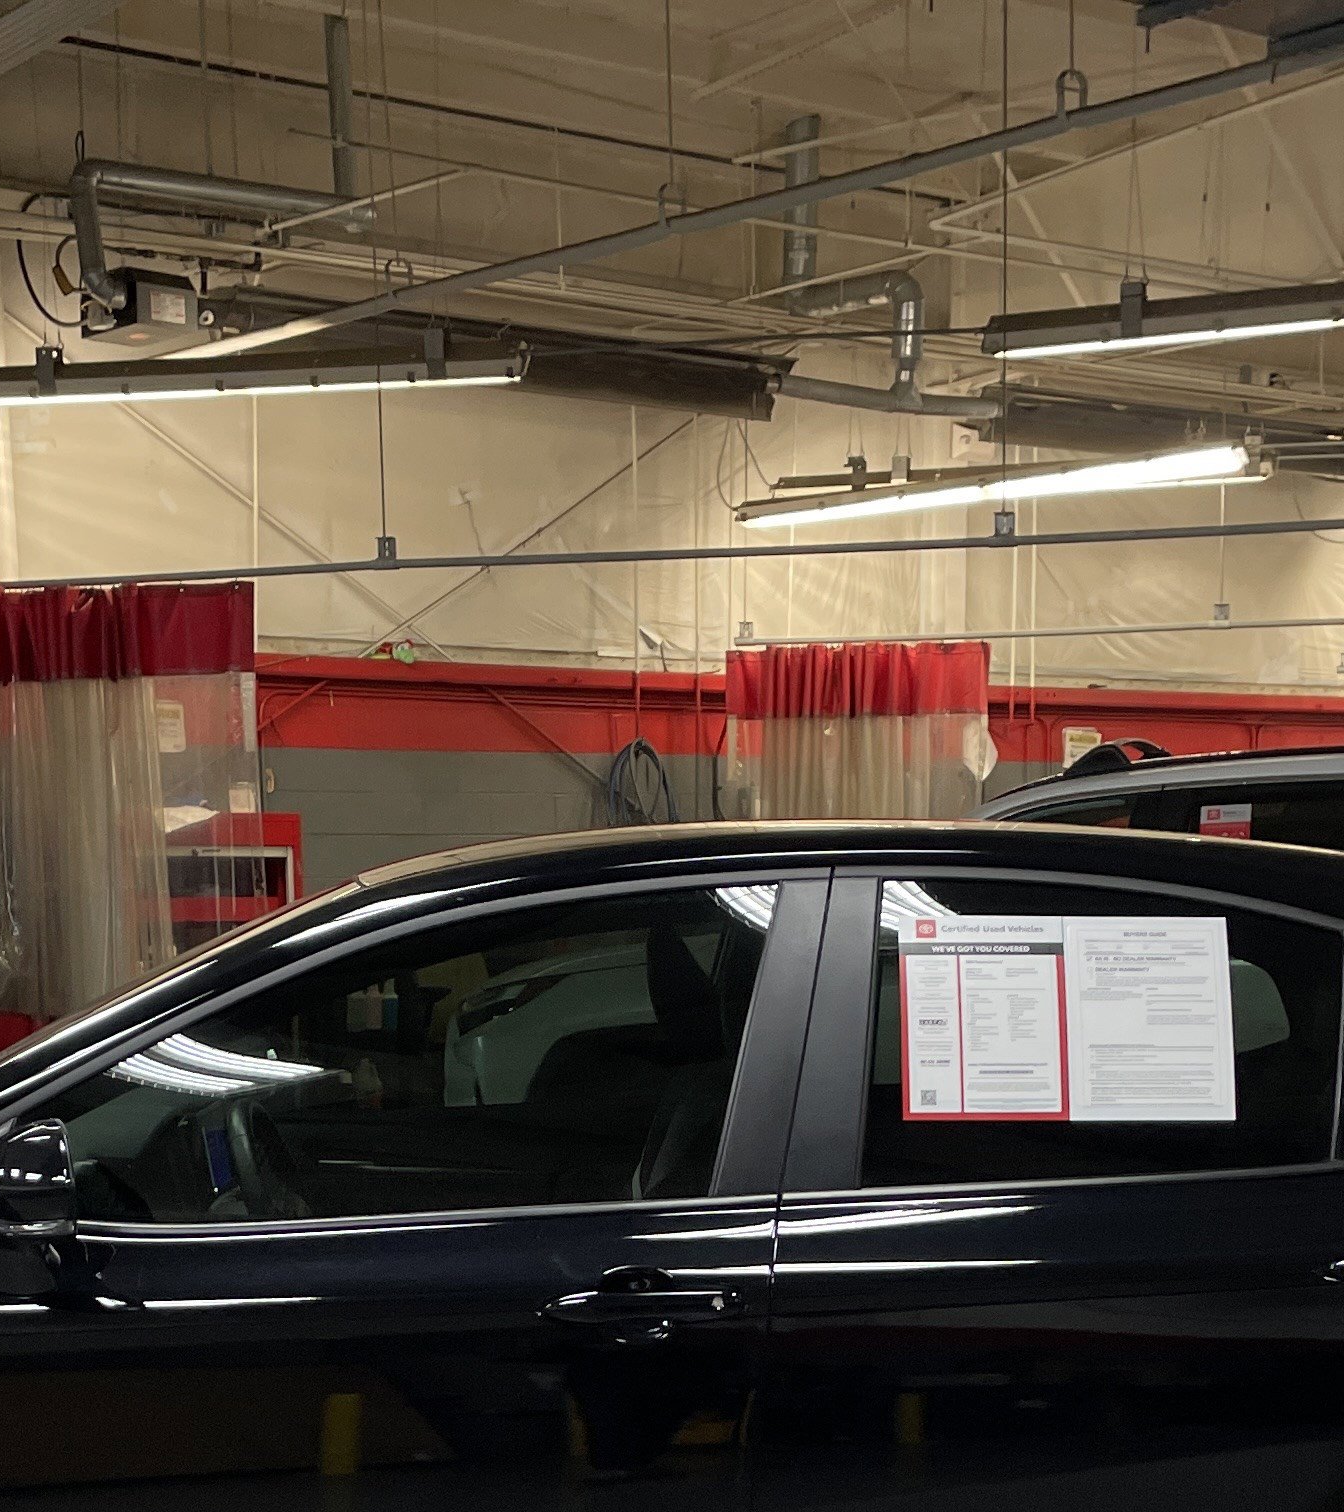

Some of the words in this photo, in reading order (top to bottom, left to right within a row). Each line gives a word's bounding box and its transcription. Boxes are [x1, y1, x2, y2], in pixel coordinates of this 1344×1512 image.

[941, 925, 980, 933] Certified
[983, 925, 1006, 933] Used
[1008, 925, 1044, 933] Vehicles
[956, 945, 974, 953] GOT
[975, 945, 992, 953] YOU
[992, 945, 1031, 953] COVERED
